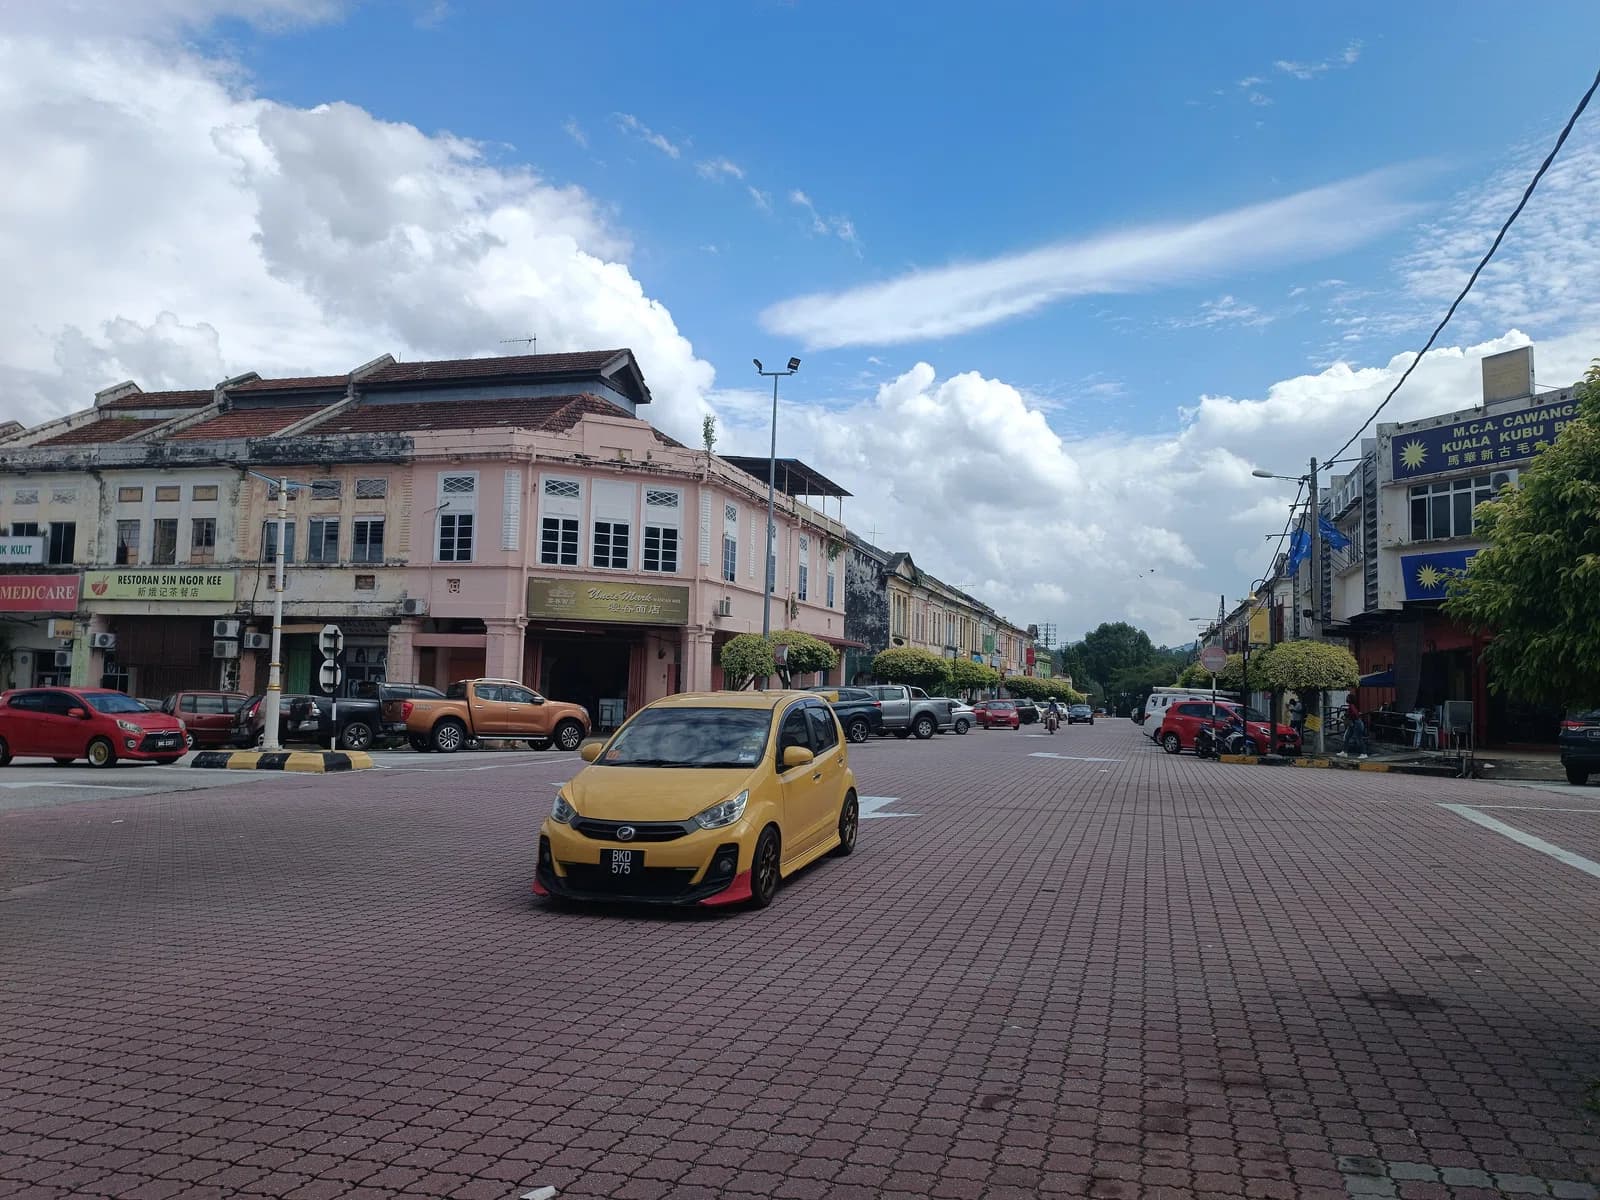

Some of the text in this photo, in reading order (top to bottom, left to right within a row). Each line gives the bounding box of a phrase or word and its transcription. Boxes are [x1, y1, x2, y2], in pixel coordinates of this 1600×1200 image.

[1453, 421, 1499, 438] M.C.A.
[1441, 436, 1491, 454] KUALA
[1500, 425, 1544, 443] KUBU
[10, 544, 32, 556] KULIT
[117, 575, 222, 586] RESTORAN SIN NGOR KEE
[0, 585, 75, 600] MEDICARE
[612, 849, 632, 862] BKD
[611, 862, 631, 874] 575
